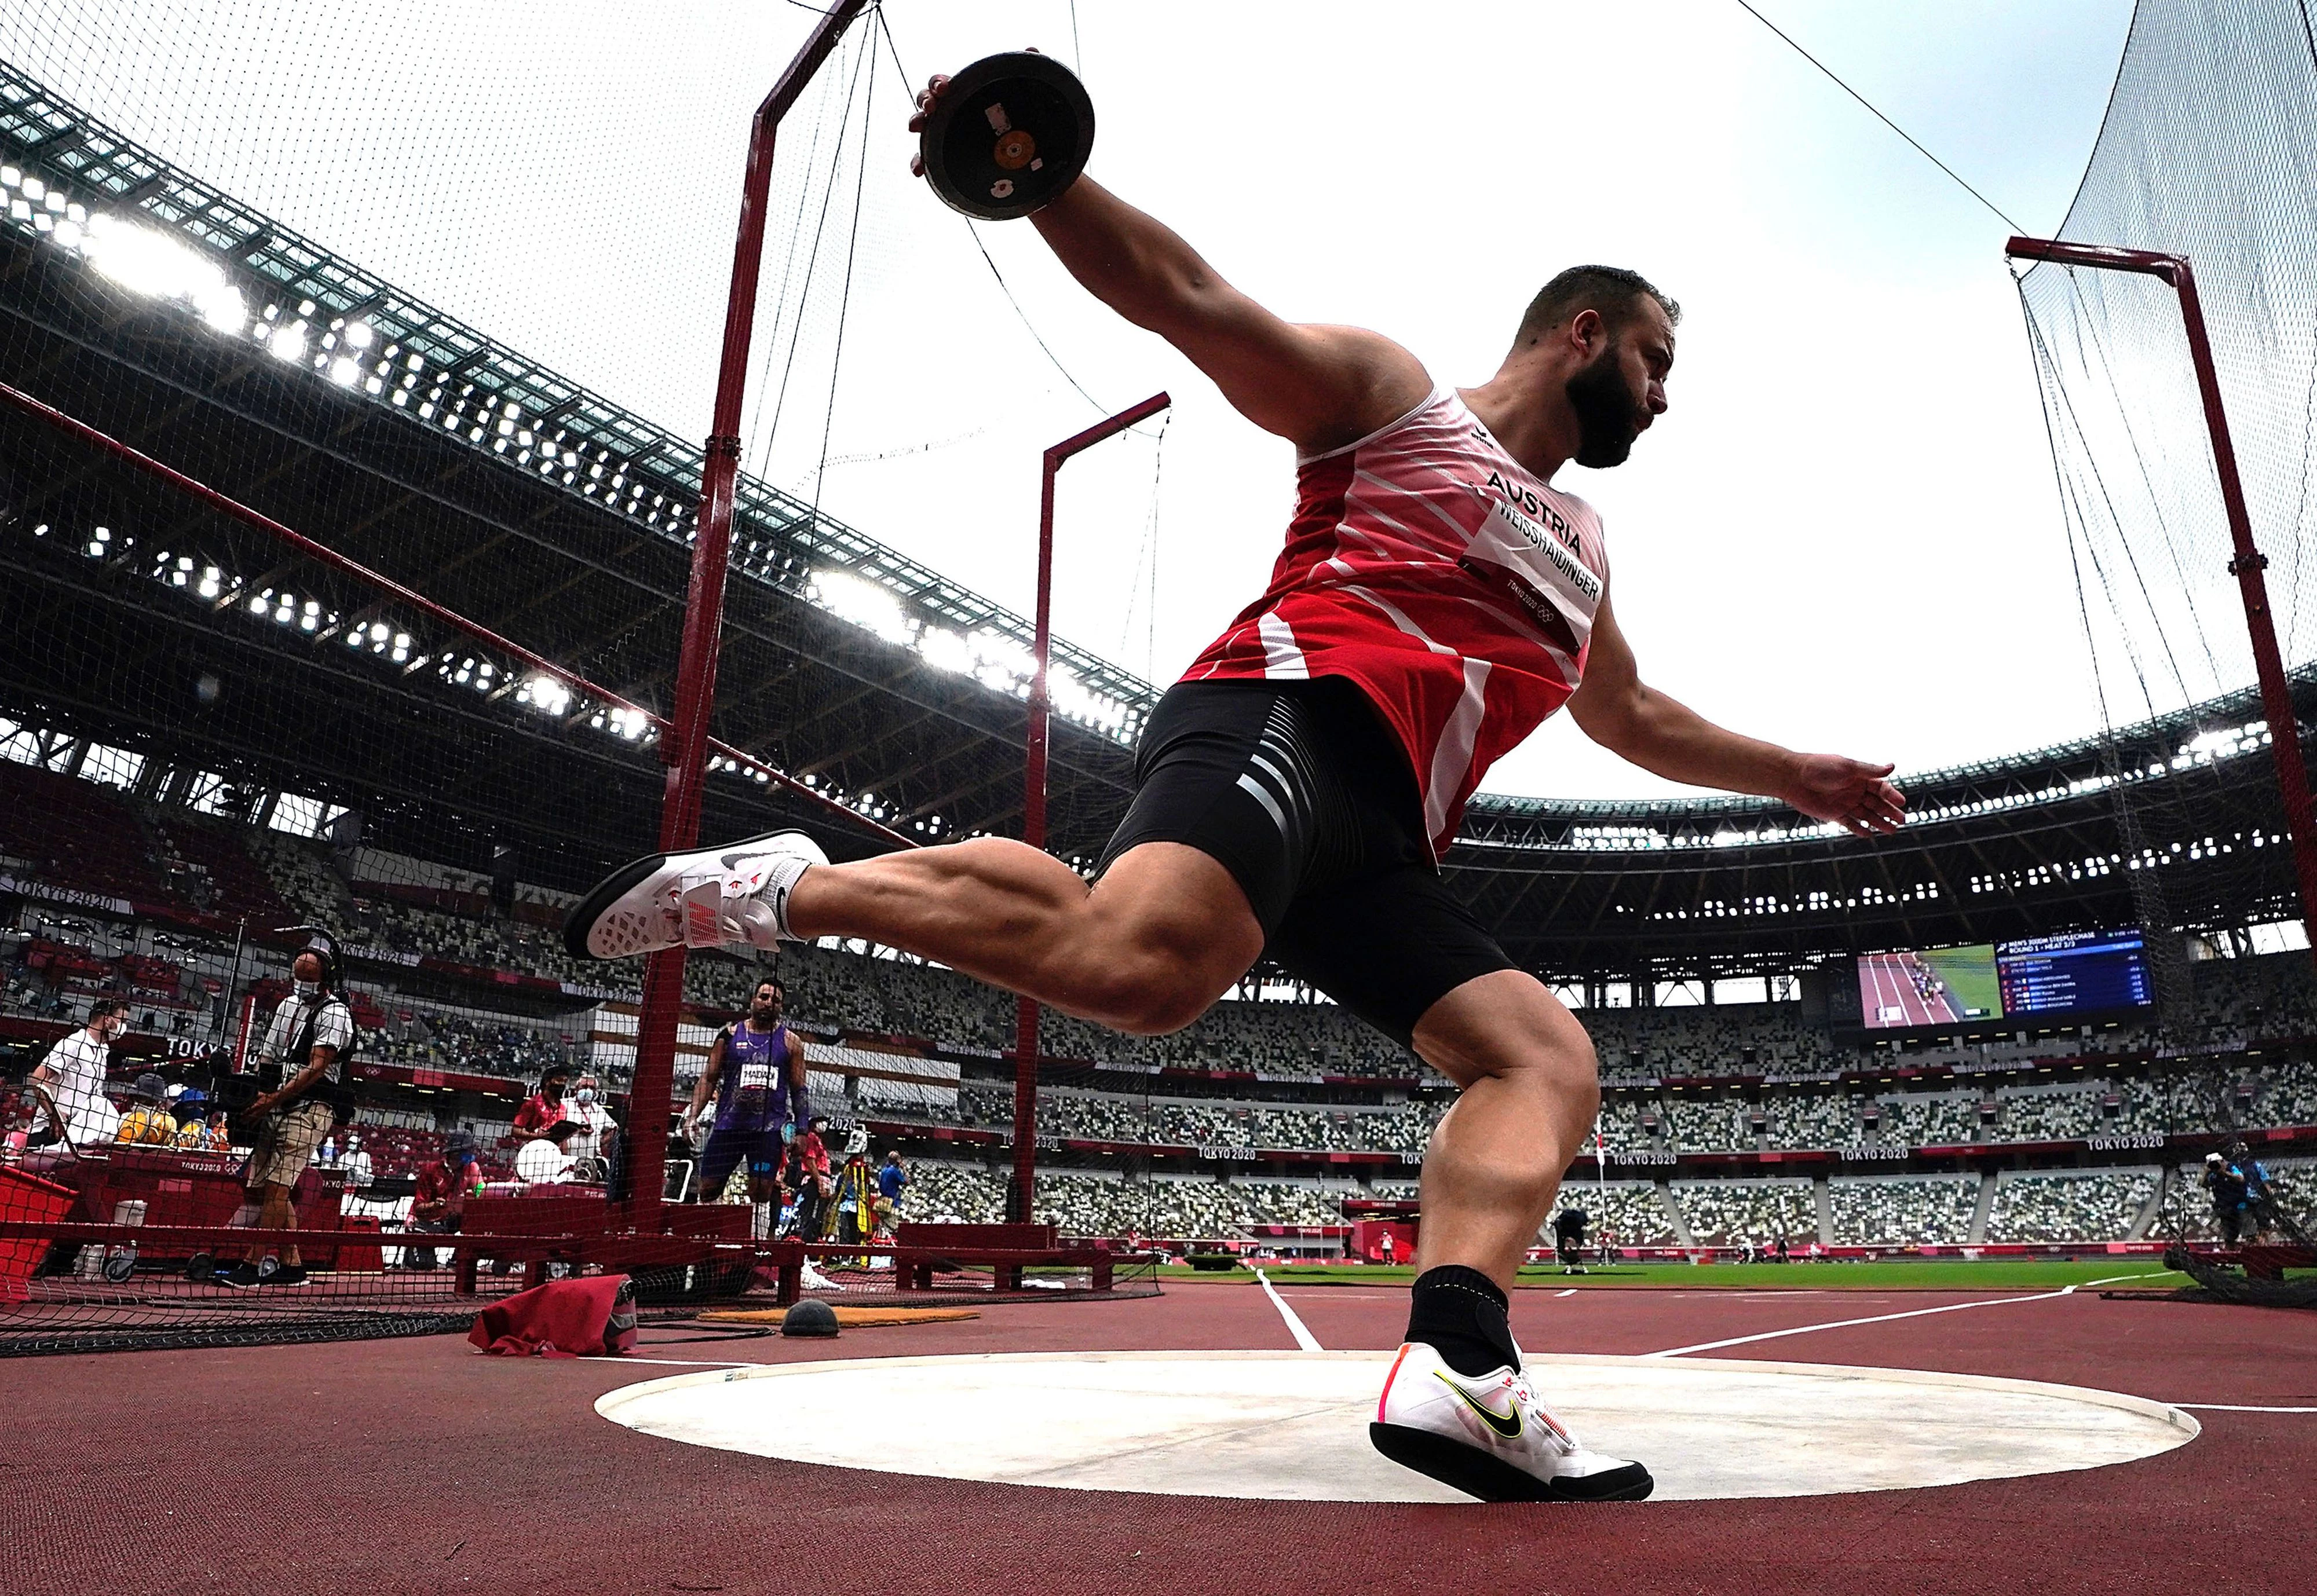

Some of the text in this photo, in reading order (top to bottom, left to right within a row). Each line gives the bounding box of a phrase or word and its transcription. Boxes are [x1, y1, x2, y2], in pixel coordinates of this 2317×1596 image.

[1487, 472, 1581, 558] AUSTRIA
[1500, 500, 1598, 602] WEISSHAIDINGER
[1507, 579, 1537, 609] TOKYO 2020
[167, 1038, 219, 1059] TOKY
[829, 1117, 856, 1131] 2020
[1035, 1135, 1058, 1148] 2020
[2086, 1136, 2164, 1151] TOKYO 2020
[1198, 1147, 1256, 1160] TOKYO 2020
[1401, 1152, 1421, 1165] TOK
[1613, 1153, 1677, 1165] TOKYO 2020
[1840, 1148, 1909, 1161] TOKYO 2020
